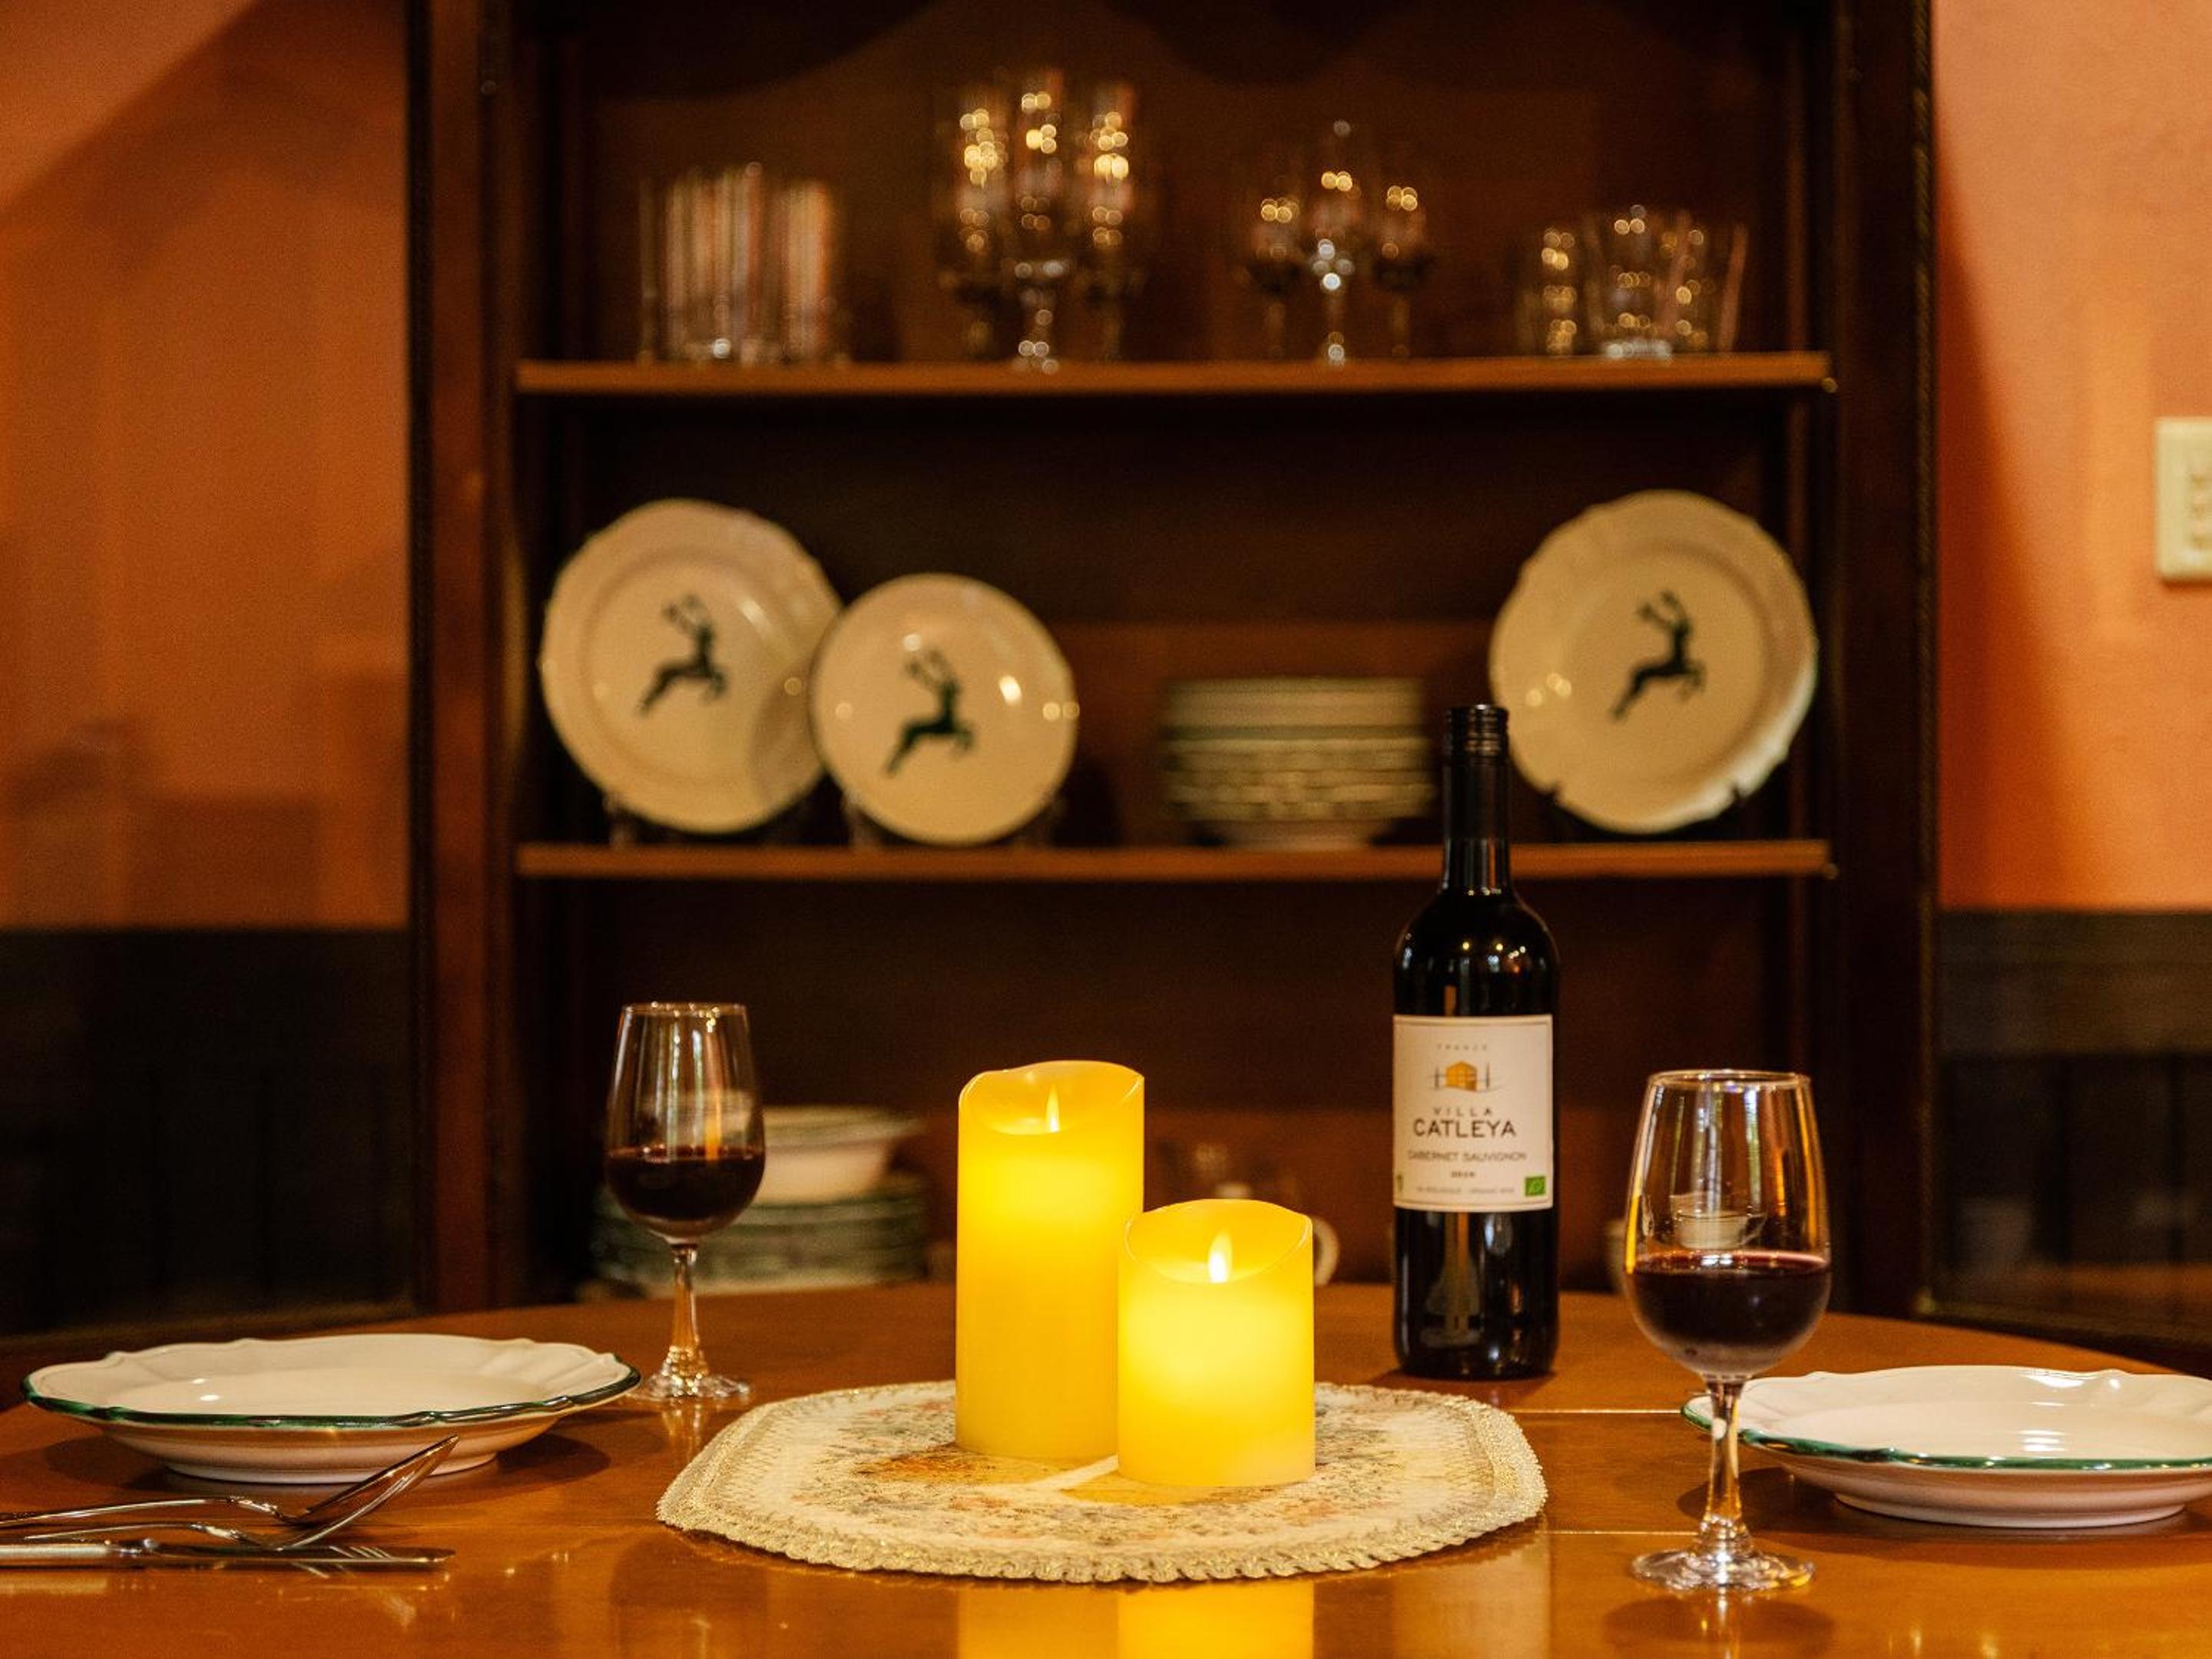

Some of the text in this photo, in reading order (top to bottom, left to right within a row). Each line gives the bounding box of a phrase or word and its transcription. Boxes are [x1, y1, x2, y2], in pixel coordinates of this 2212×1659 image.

[1433, 1108, 1492, 1117] VILLA
[1413, 1118, 1516, 1138] CATLEYA
[1407, 1150, 1527, 1162] CABERNET SAUVIGNON
